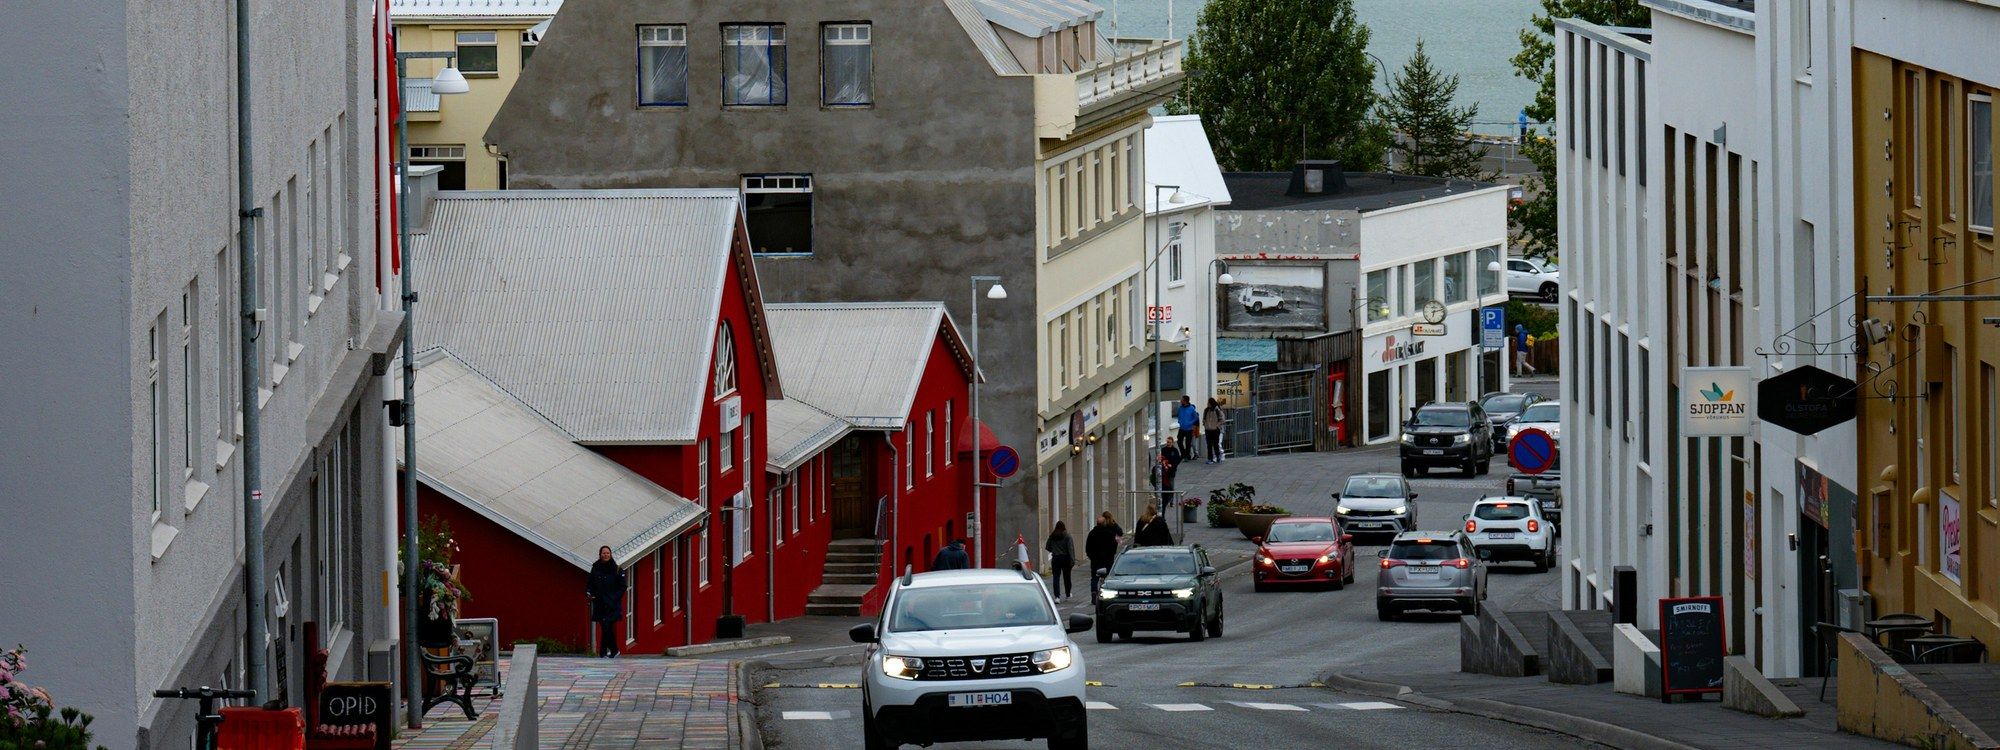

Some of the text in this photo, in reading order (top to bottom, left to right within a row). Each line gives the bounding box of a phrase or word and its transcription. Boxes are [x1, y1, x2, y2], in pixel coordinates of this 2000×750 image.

[1486, 311, 1496, 325] P
[1690, 403, 1746, 415] SJOPPAN
[1676, 604, 1708, 613] SMIRNOFF
[985, 693, 1009, 704] H04
